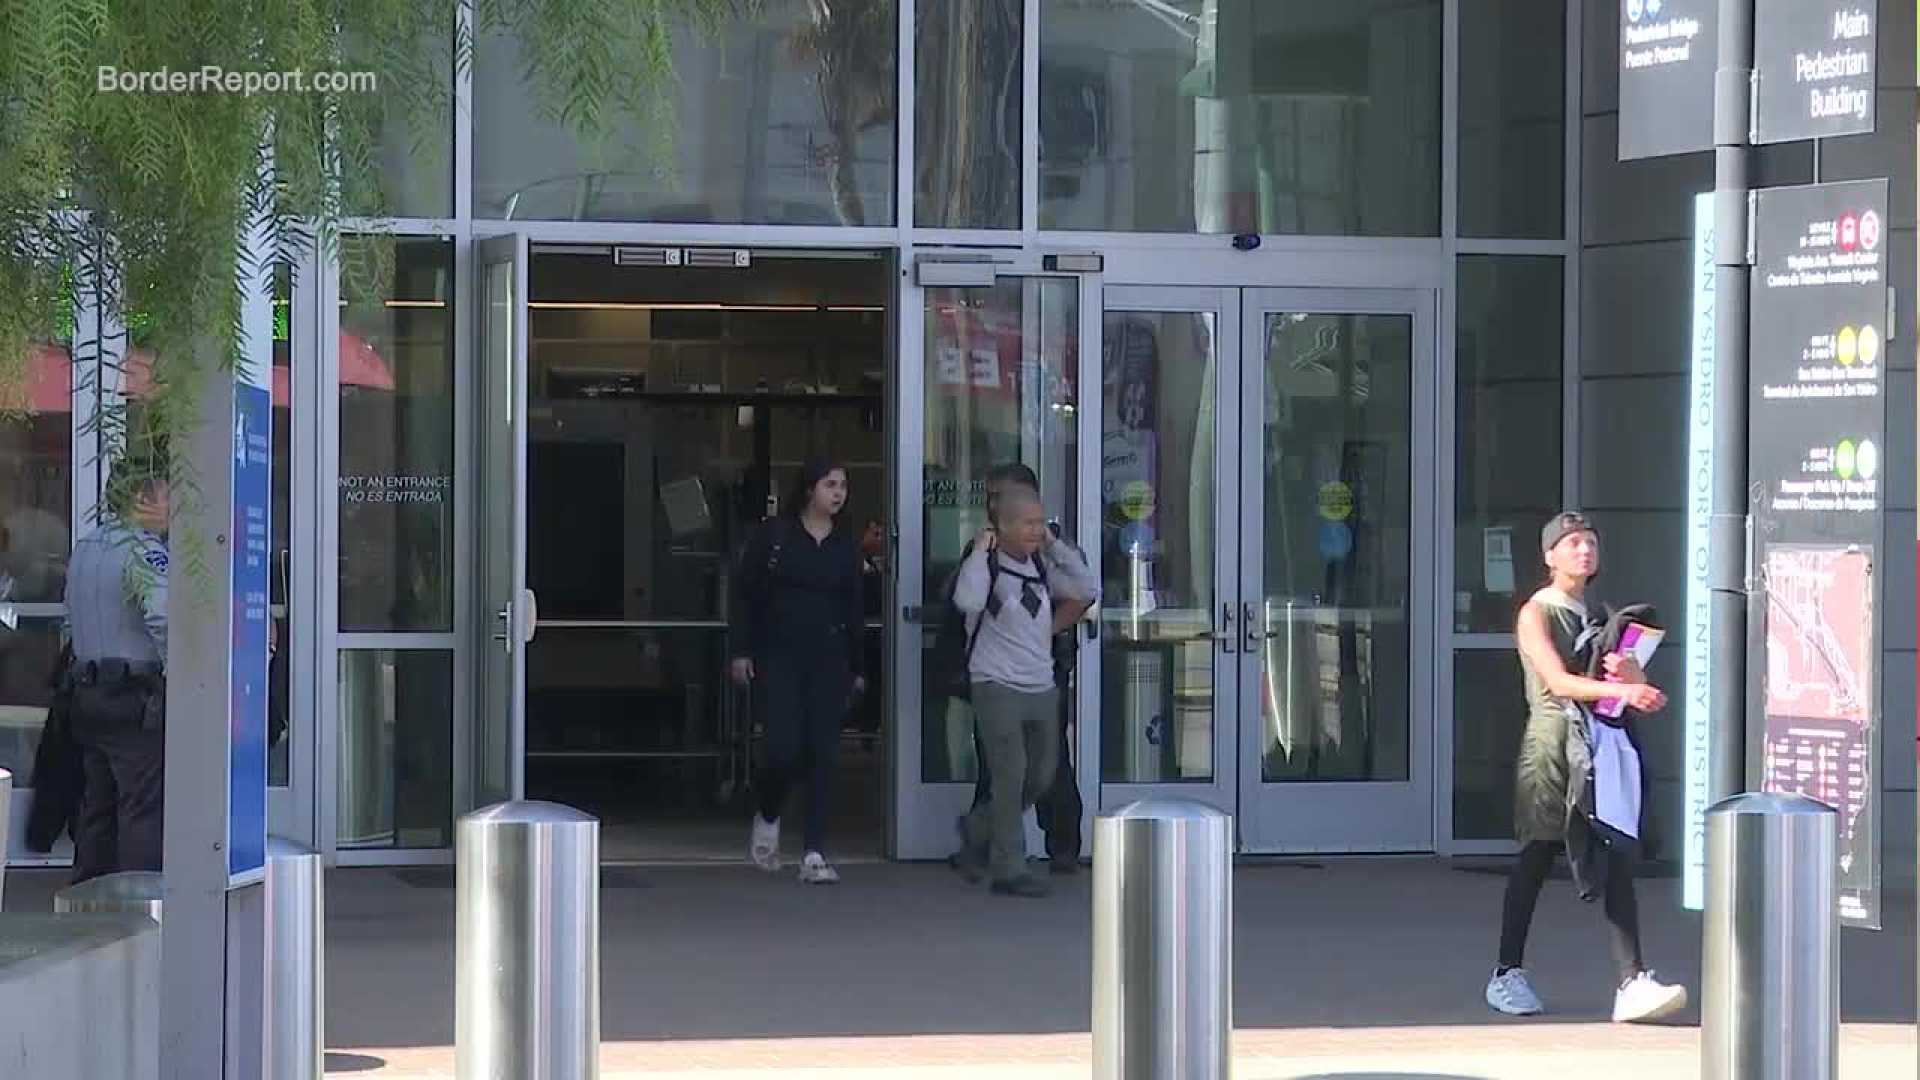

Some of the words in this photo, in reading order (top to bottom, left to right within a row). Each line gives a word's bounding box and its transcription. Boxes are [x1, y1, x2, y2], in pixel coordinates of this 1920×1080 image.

[1833, 9, 1869, 40] Main
[1796, 47, 1868, 83] Pedestrian
[1810, 86, 1868, 119] Building
[1703, 228, 1715, 292] SAN
[1700, 304, 1713, 427] YSIDRO
[339, 476, 364, 488] NOT
[367, 476, 383, 488] AN
[386, 476, 451, 488] ENTRANCE
[346, 491, 365, 502] NO
[367, 491, 383, 502] ES
[386, 491, 442, 502] ENTRADA
[1697, 450, 1710, 536] PORT
[1694, 603, 1707, 708] ENTRY
[1693, 720, 1707, 869] DISTRICT
